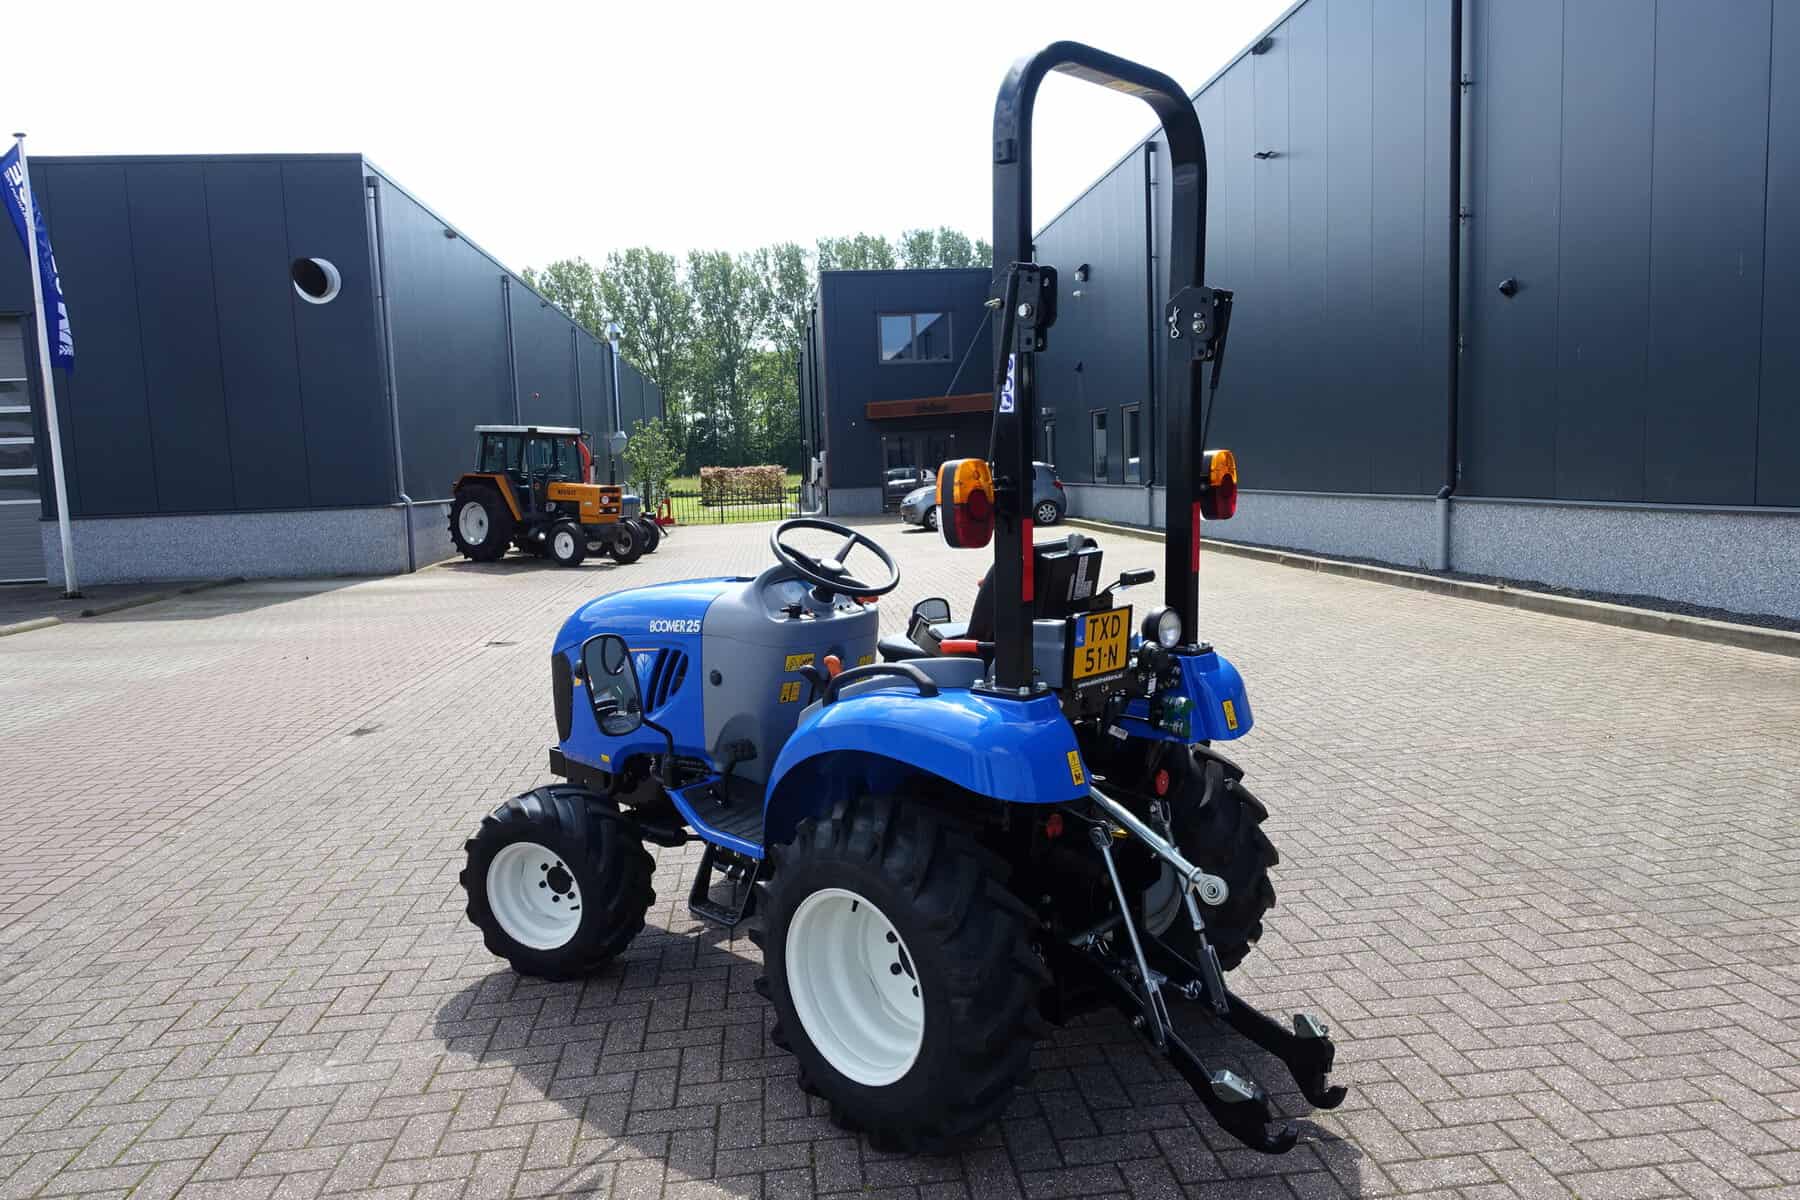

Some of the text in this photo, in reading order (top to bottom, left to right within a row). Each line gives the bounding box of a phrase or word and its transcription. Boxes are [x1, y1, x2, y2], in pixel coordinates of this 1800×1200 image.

[649, 619, 700, 632] BOOMER 25
[1089, 615, 1120, 642] TXD
[1085, 643, 1118, 672] 51-N
